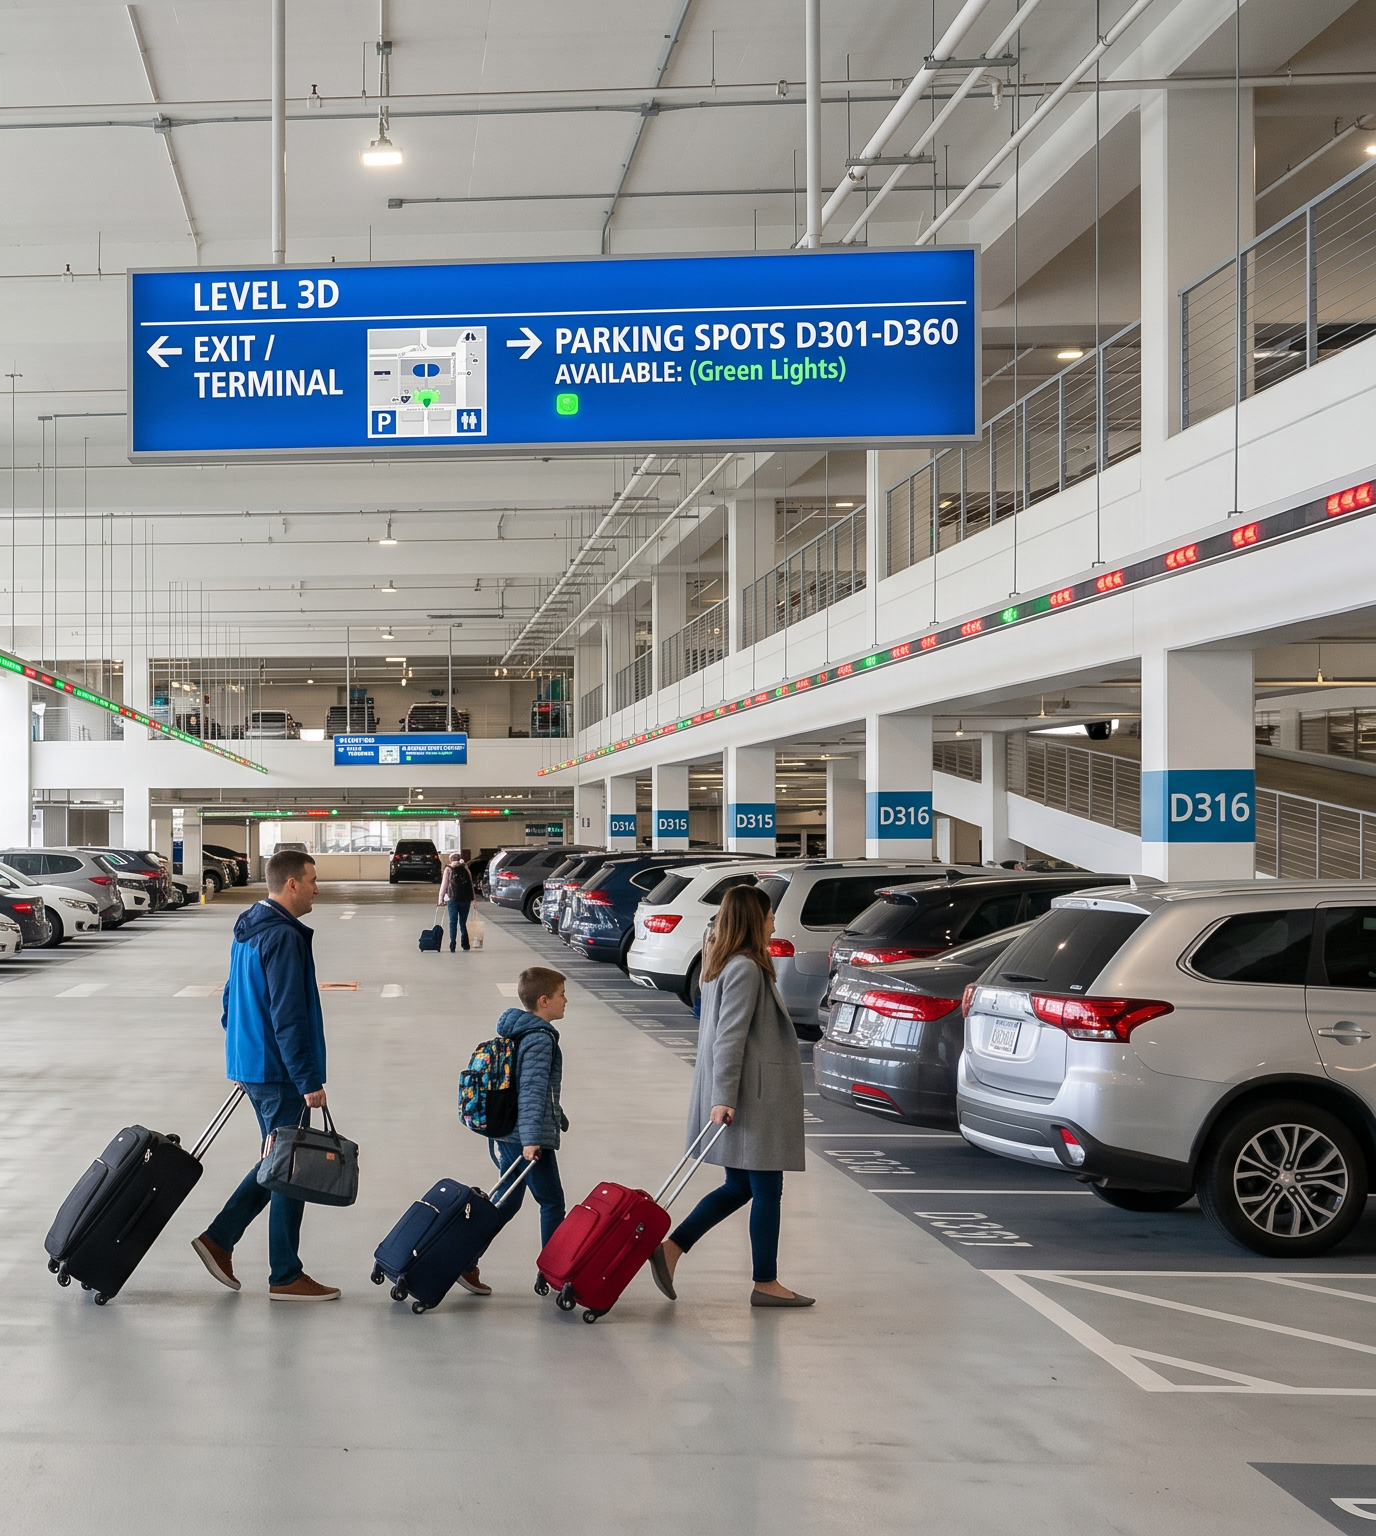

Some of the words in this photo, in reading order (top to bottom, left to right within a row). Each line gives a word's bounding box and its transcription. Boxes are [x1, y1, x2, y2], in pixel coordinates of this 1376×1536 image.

[194, 280, 287, 312] LEVEL
[297, 279, 340, 310] 3D
[194, 334, 256, 363] EXIT
[264, 334, 276, 361] /
[555, 325, 684, 355] PARKING
[694, 322, 786, 351] SPOTS
[796, 317, 959, 349] D301-D360
[193, 368, 344, 399] TERMINAL
[554, 361, 682, 385] AVAILABLE:
[689, 359, 763, 386] (Green
[771, 355, 846, 386] Lights)
[377, 412, 392, 433] P
[736, 813, 773, 829] D315
[880, 806, 930, 826] D316
[1171, 792, 1250, 822] D316
[611, 821, 635, 831] D314
[659, 818, 687, 830] D315
